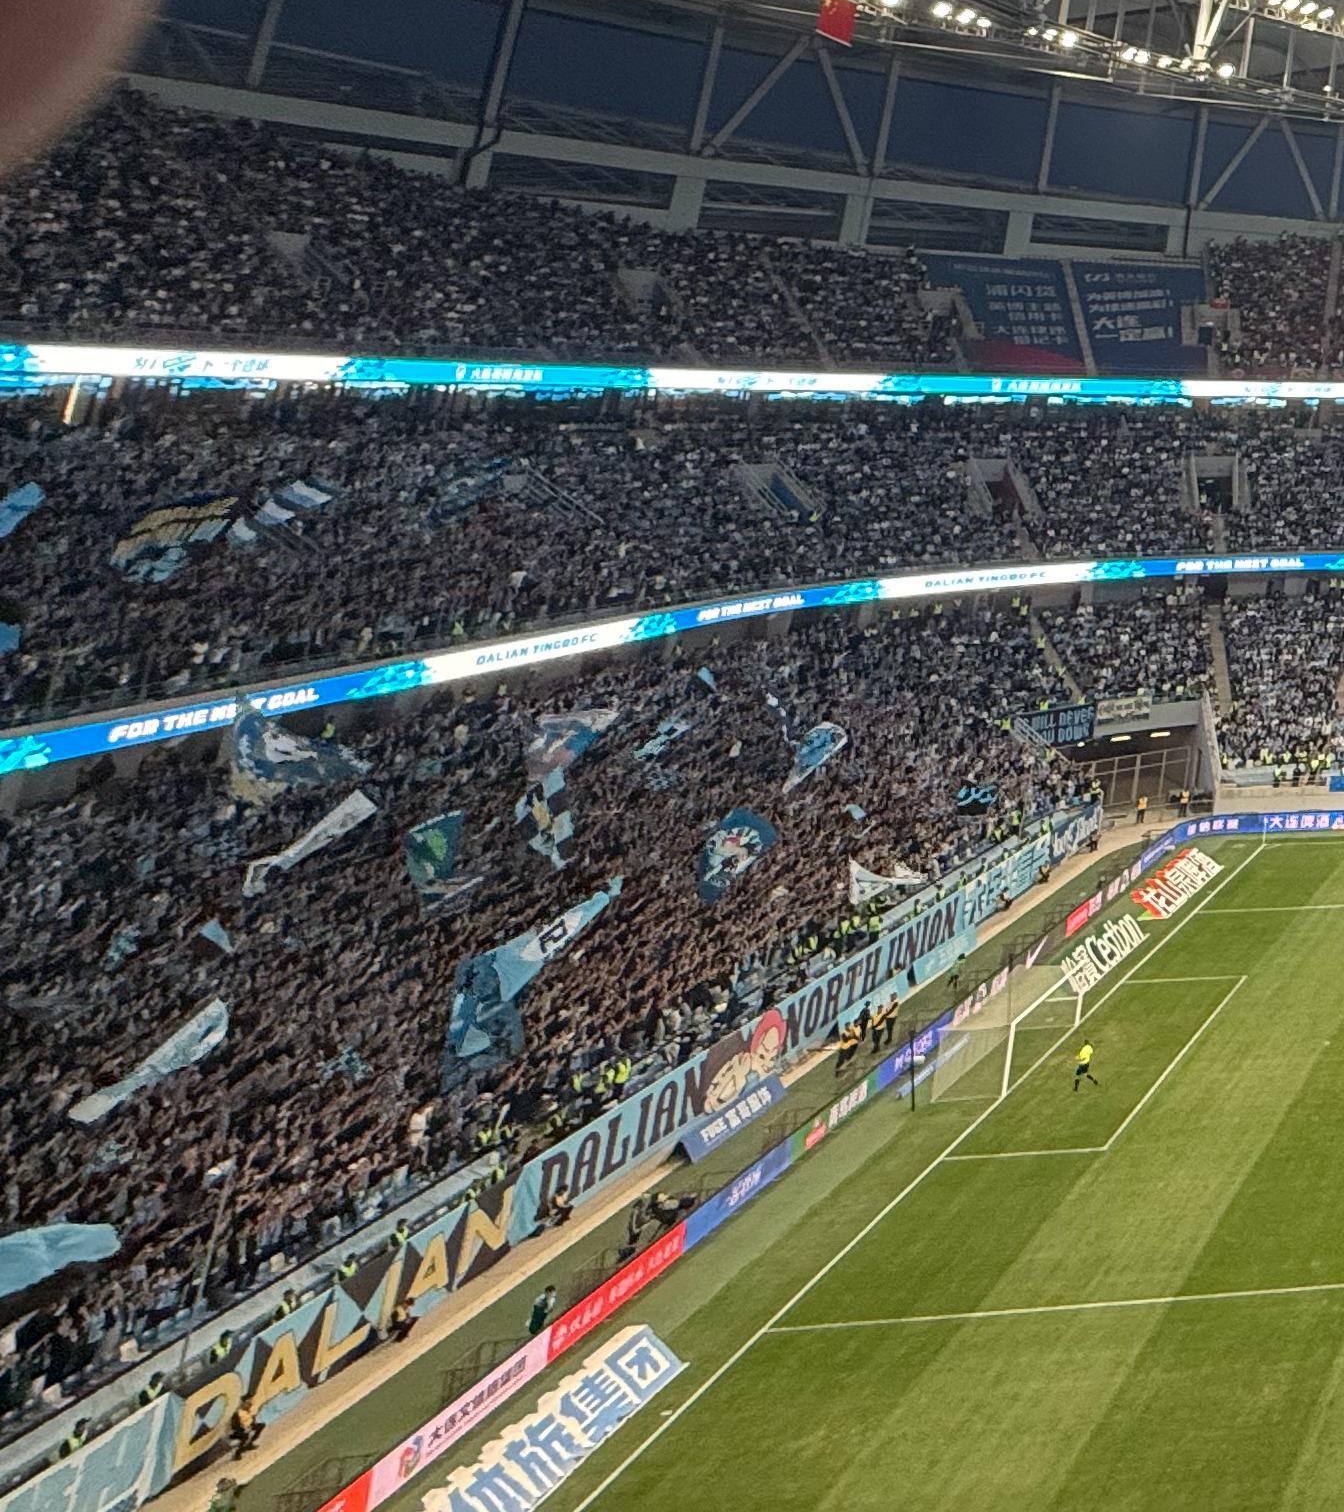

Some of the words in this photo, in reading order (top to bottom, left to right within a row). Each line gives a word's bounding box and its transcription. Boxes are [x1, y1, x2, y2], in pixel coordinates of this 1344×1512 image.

[476, 647, 530, 665] DALIAN
[107, 719, 159, 743] FOR
[162, 710, 209, 731] THE
[210, 697, 267, 721] NET
[268, 687, 320, 710] GOAL
[1269, 814, 1330, 829] 大连啤酒
[534, 1046, 707, 1220] DALIAN
[785, 946, 882, 1049] NORTH
[887, 896, 960, 978] UNION
[172, 1184, 515, 1470] DALIAN
